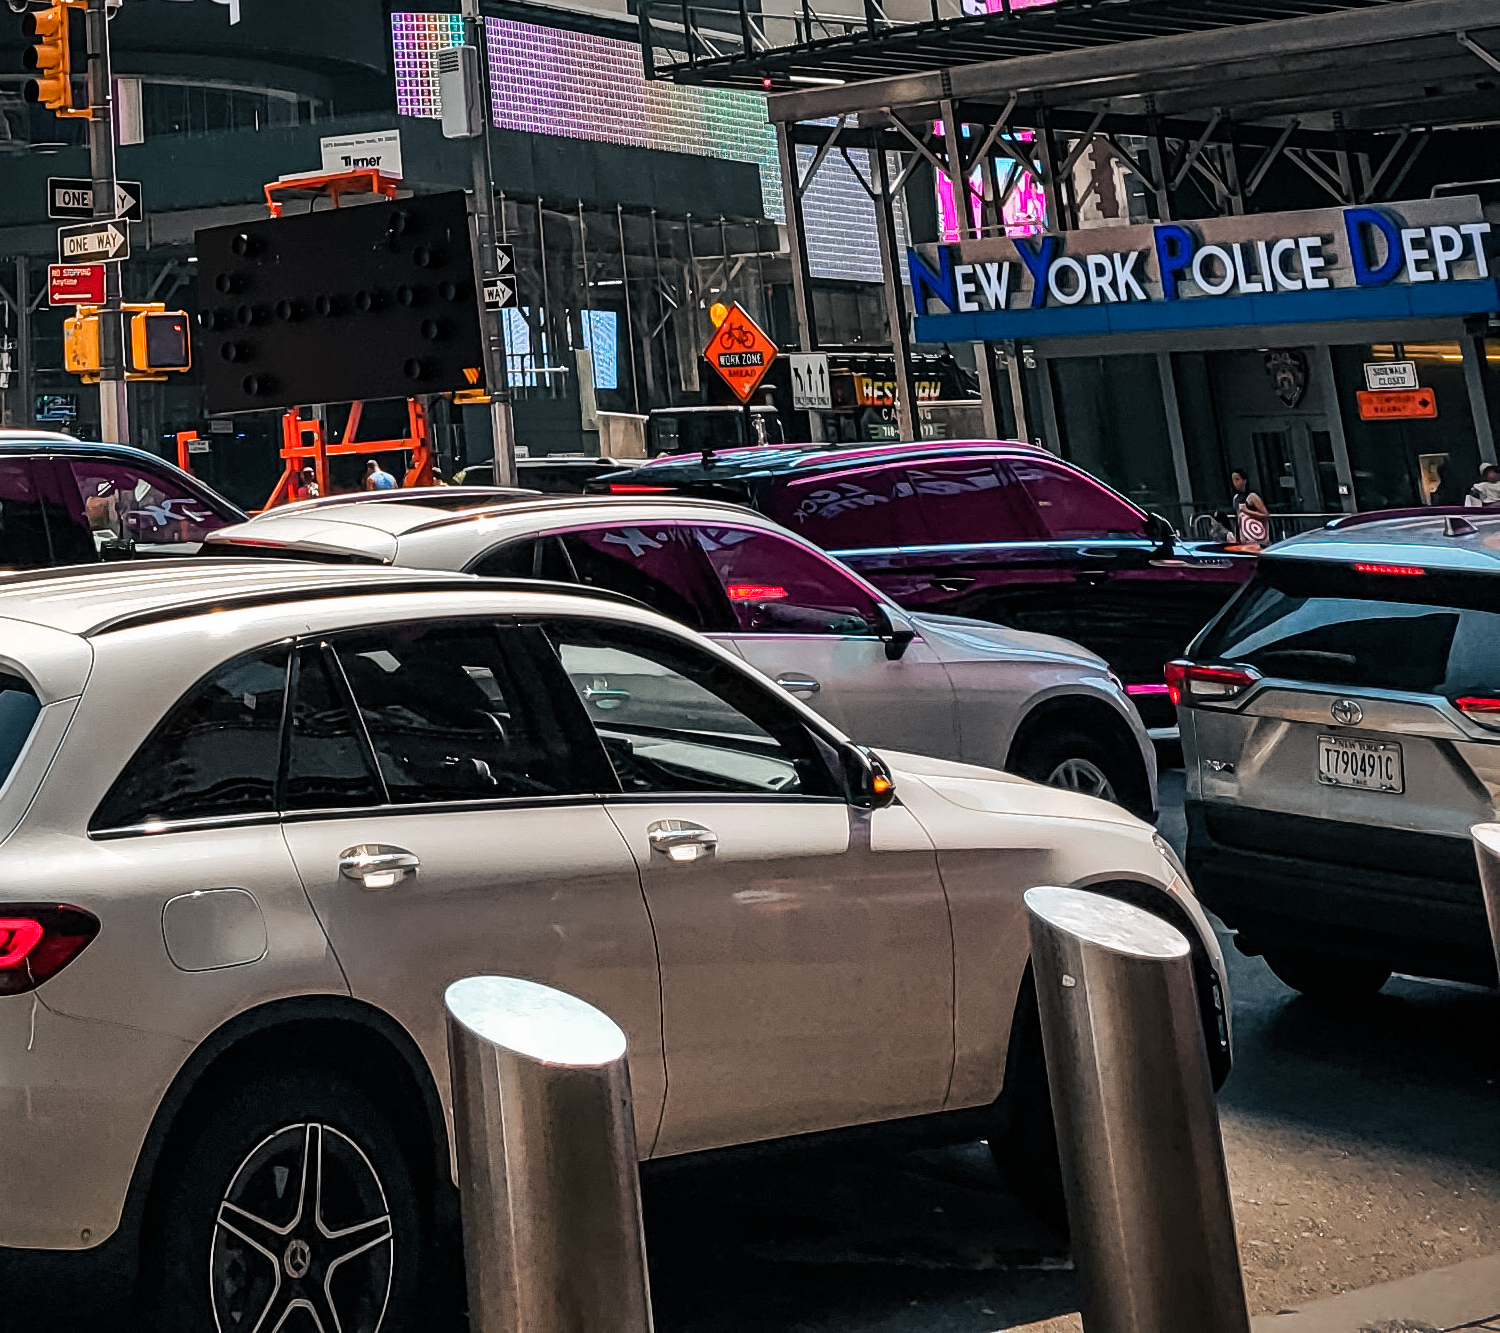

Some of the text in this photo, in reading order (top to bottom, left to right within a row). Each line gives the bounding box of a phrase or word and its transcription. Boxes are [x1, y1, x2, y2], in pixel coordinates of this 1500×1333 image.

[62, 191, 89, 206] ONE
[69, 233, 118, 253] ONE WAY
[486, 287, 506, 301] WAY
[719, 353, 762, 366] WORK ZONE
[1324, 746, 1394, 782] T790491C
